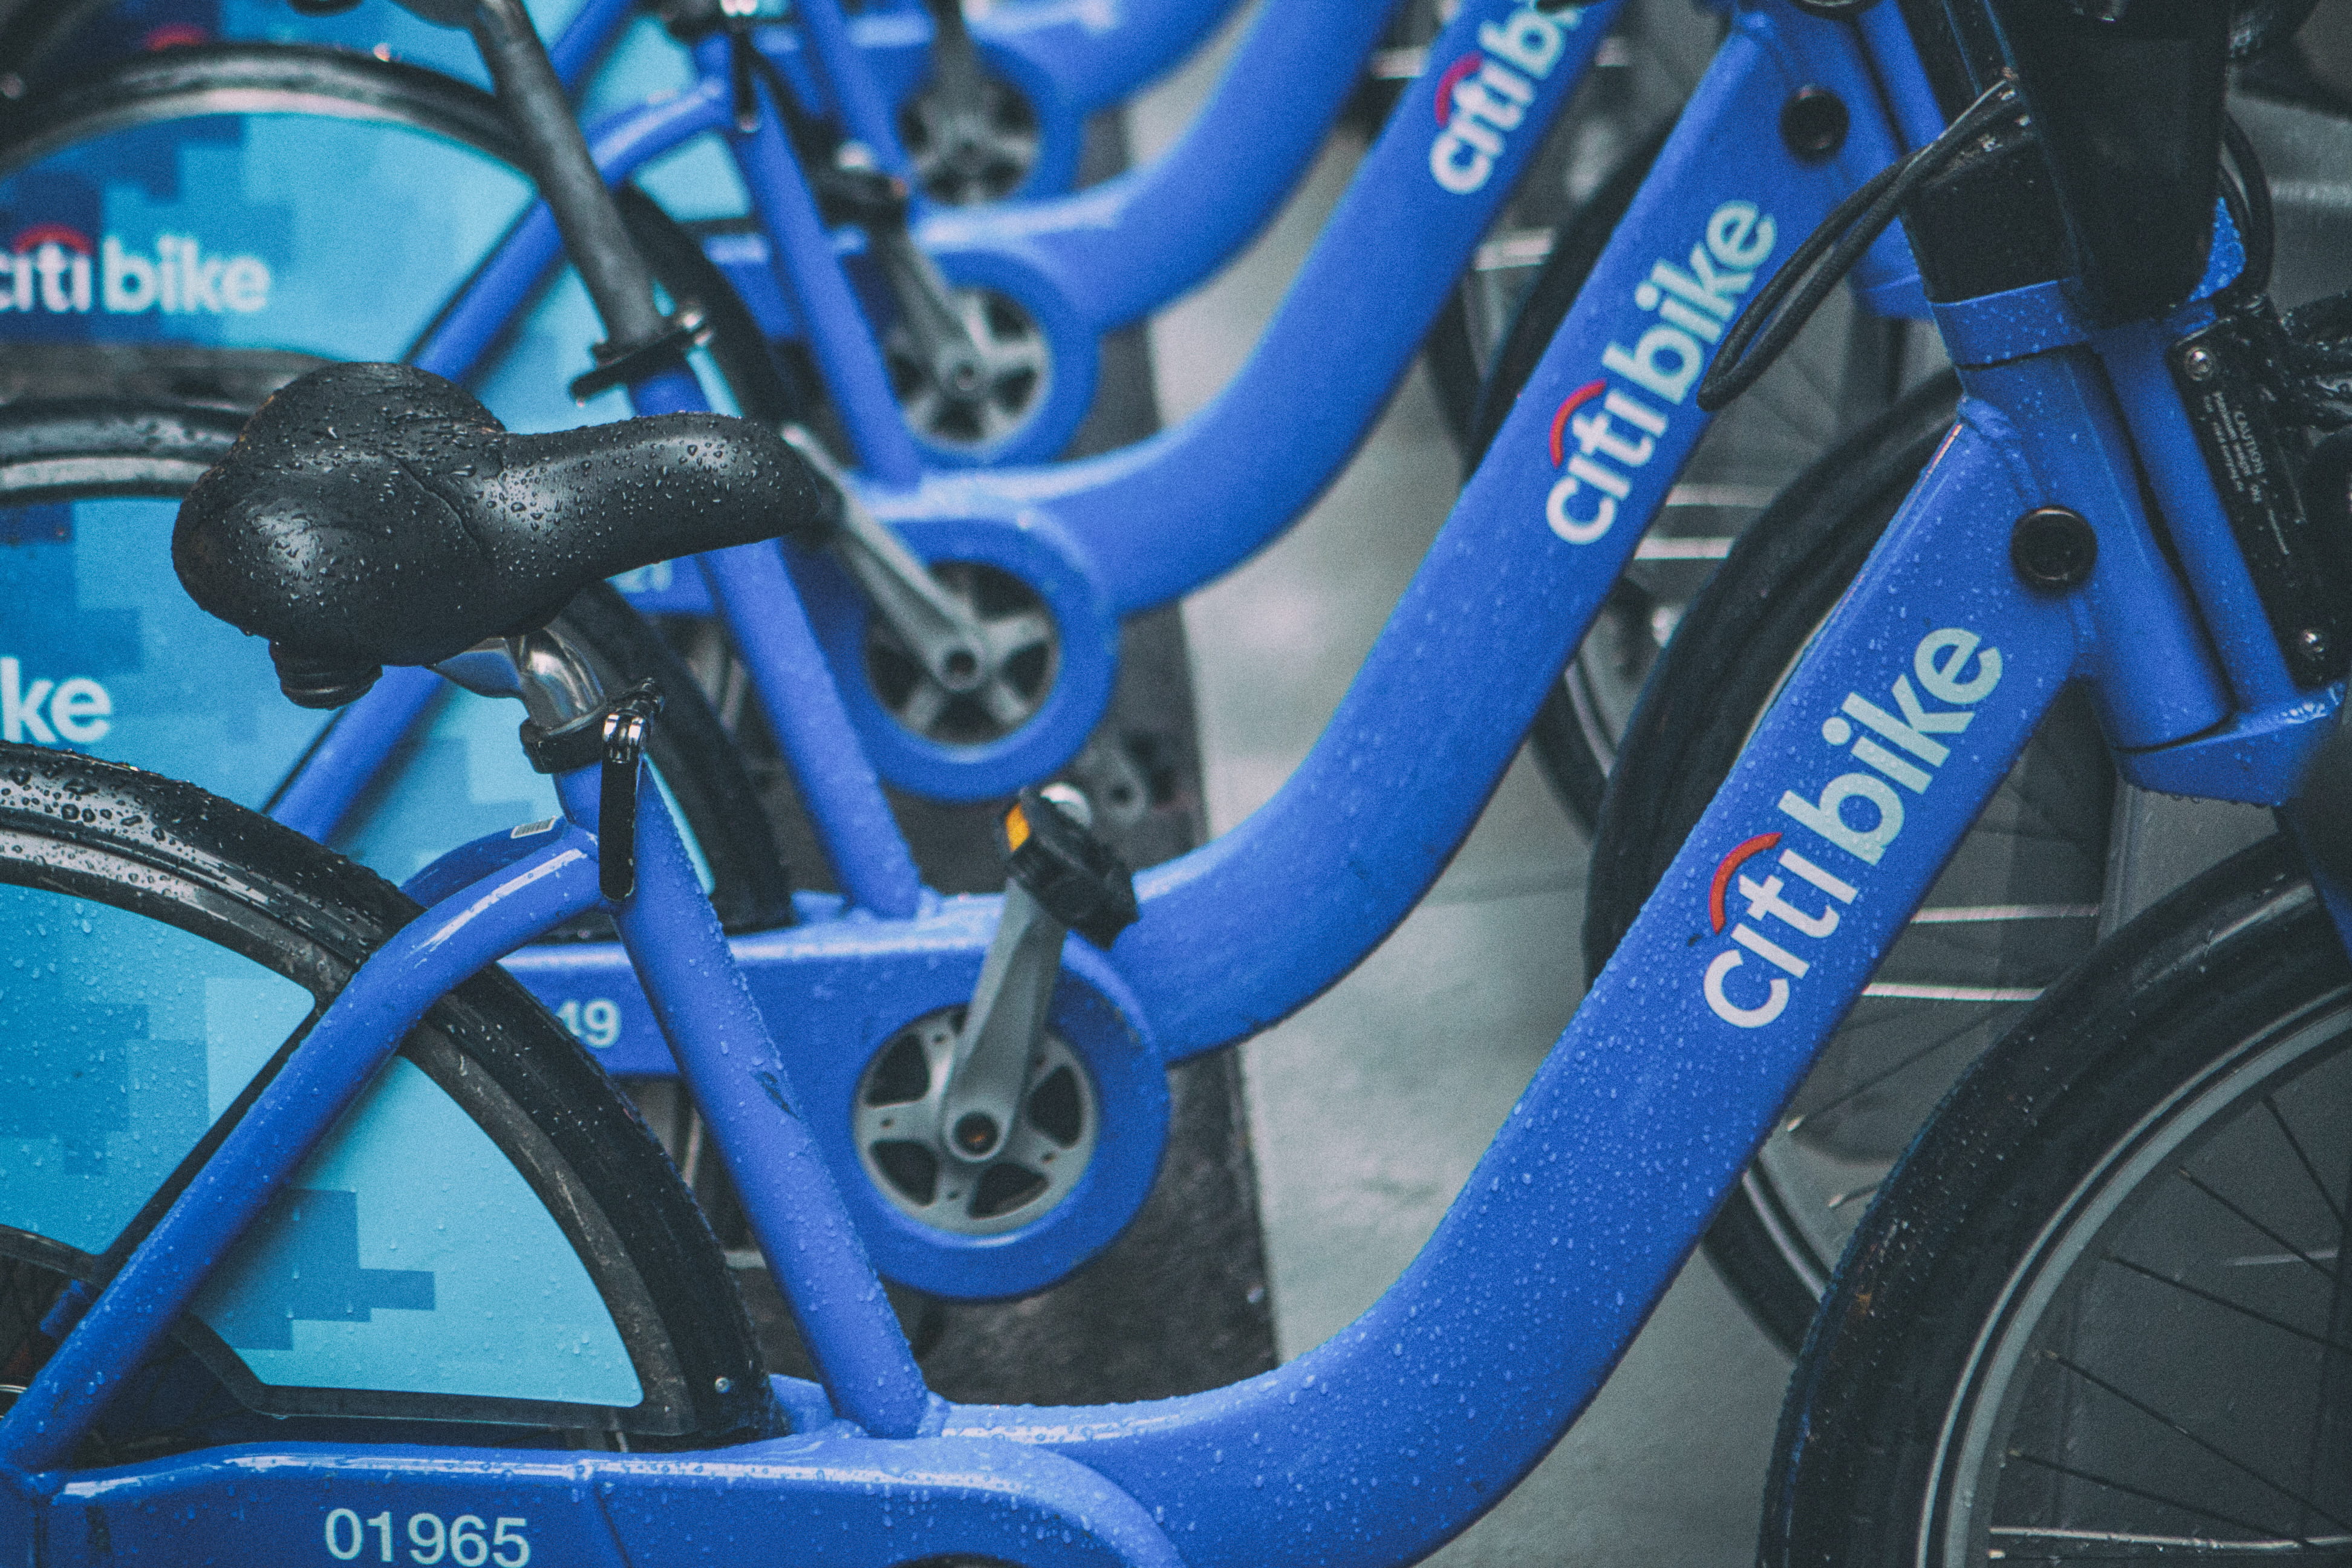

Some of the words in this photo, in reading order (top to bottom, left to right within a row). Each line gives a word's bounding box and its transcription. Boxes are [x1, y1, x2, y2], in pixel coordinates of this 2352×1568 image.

[1429, 53, 1535, 195] citi
[102, 233, 271, 314] bike
[1601, 200, 1778, 405] bike
[1545, 380, 1668, 544] citi
[2234, 411, 2266, 474] CAUTION
[0, 656, 112, 743] ke
[1777, 628, 2003, 866] bike
[1703, 833, 1858, 1028] citi
[324, 1508, 531, 1568] 01965
